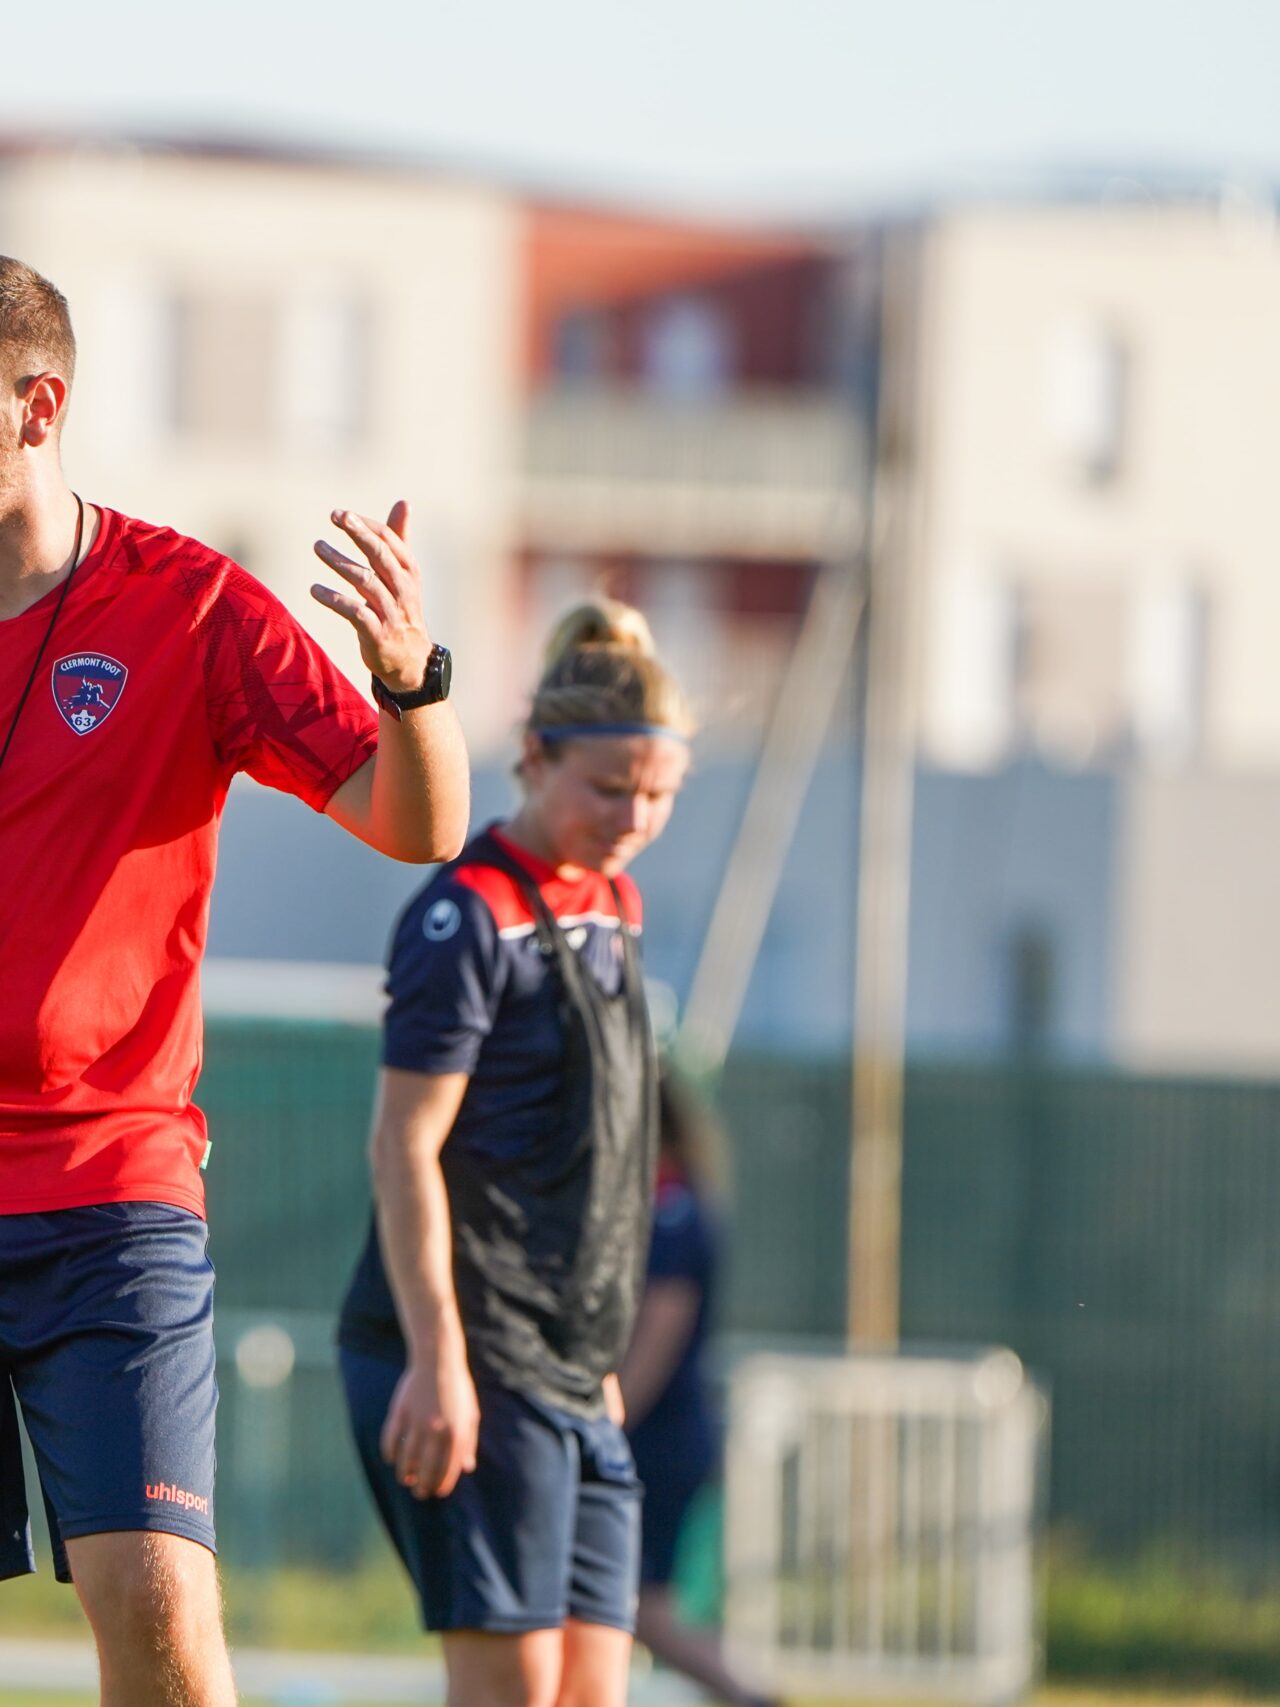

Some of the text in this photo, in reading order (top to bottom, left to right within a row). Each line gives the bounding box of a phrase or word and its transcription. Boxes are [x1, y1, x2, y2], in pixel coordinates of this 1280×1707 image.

[60, 657, 122, 676] CLERMONT FOOT
[74, 716, 91, 727] 63
[145, 1482, 208, 1515] uhlsport
